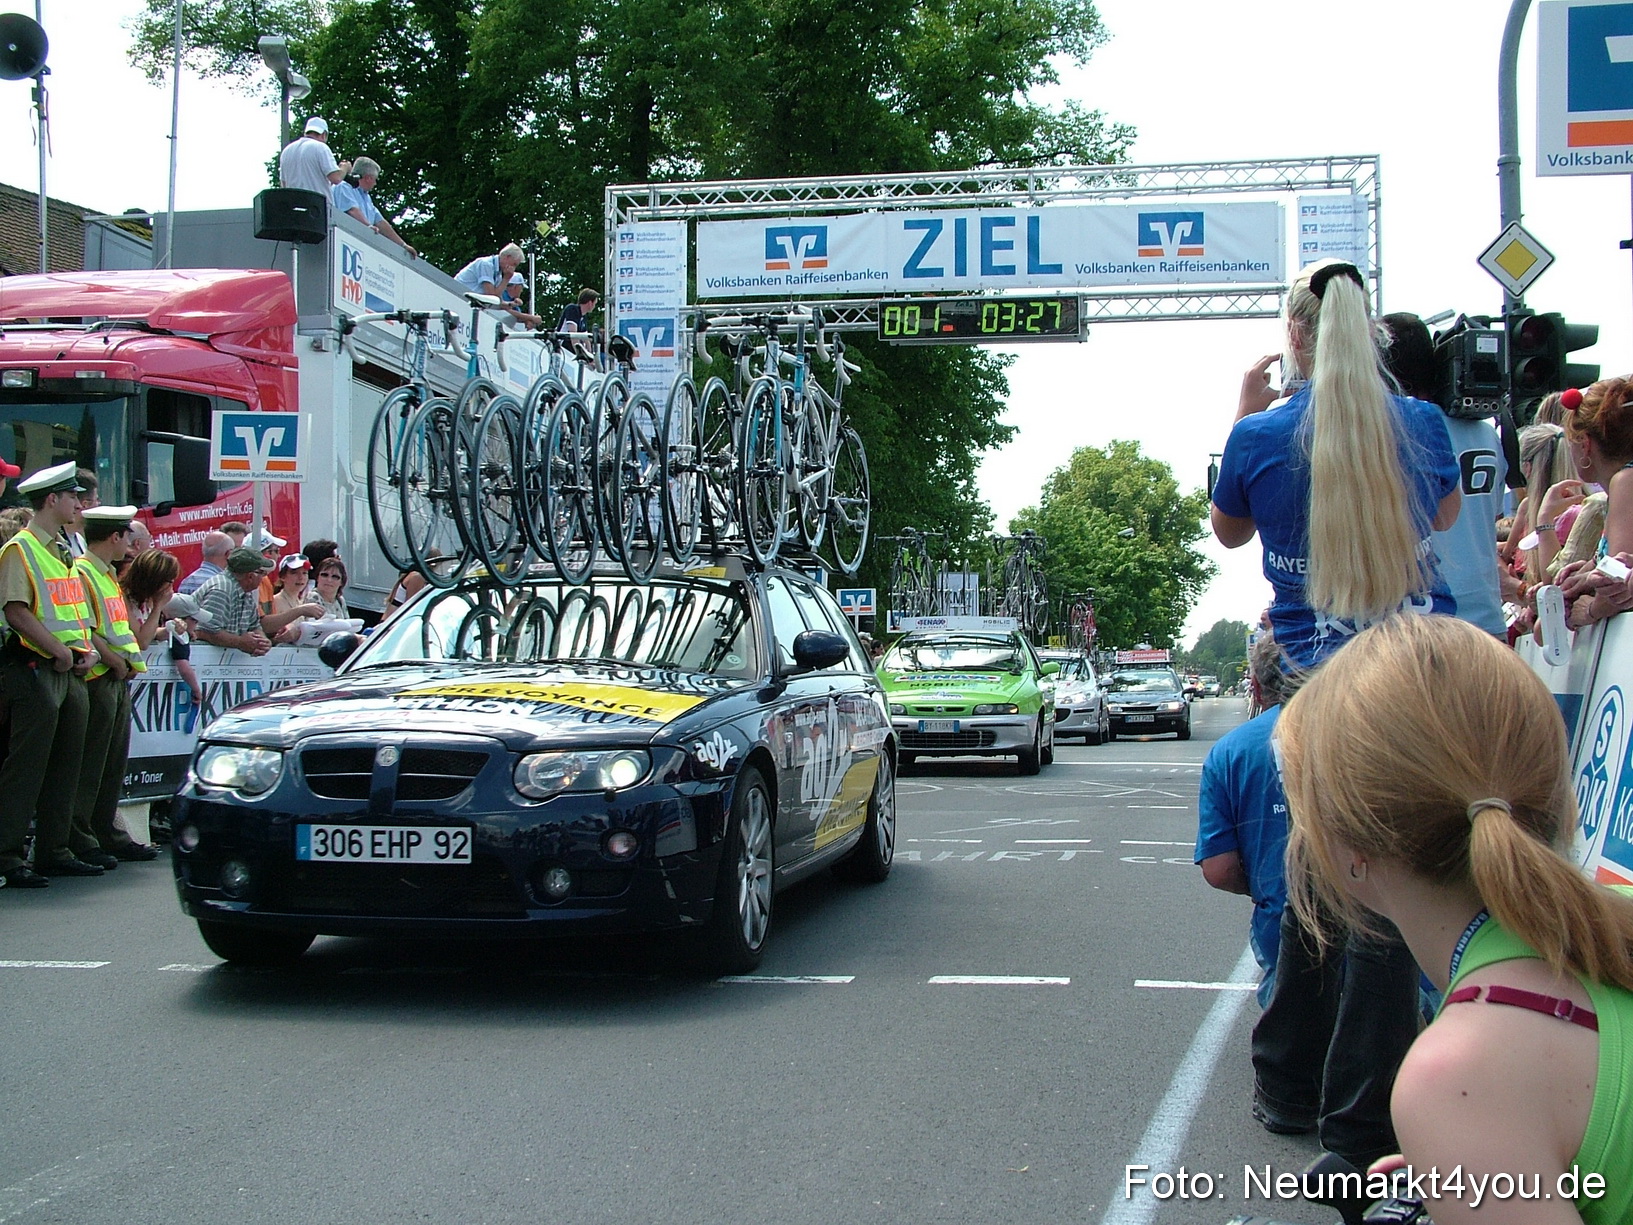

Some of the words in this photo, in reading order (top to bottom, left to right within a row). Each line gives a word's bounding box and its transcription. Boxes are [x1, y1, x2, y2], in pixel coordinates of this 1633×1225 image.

[903, 215, 1063, 278] ZIEL
[343, 244, 362, 281] DG
[1075, 263, 1155, 274] Volksbanken
[1159, 259, 1270, 273] Raiffeisenbanken
[705, 275, 781, 289] Volksbanken
[785, 268, 889, 286] Raiffeisenbanken
[981, 302, 1062, 332] 03:27
[1459, 448, 1498, 497] 6
[179, 501, 254, 522] www.mikro-funk.de
[694, 731, 738, 772] ag2r
[140, 770, 164, 784] Toner
[314, 828, 364, 858] 306
[370, 829, 423, 859] EHP
[434, 830, 470, 860] 92
